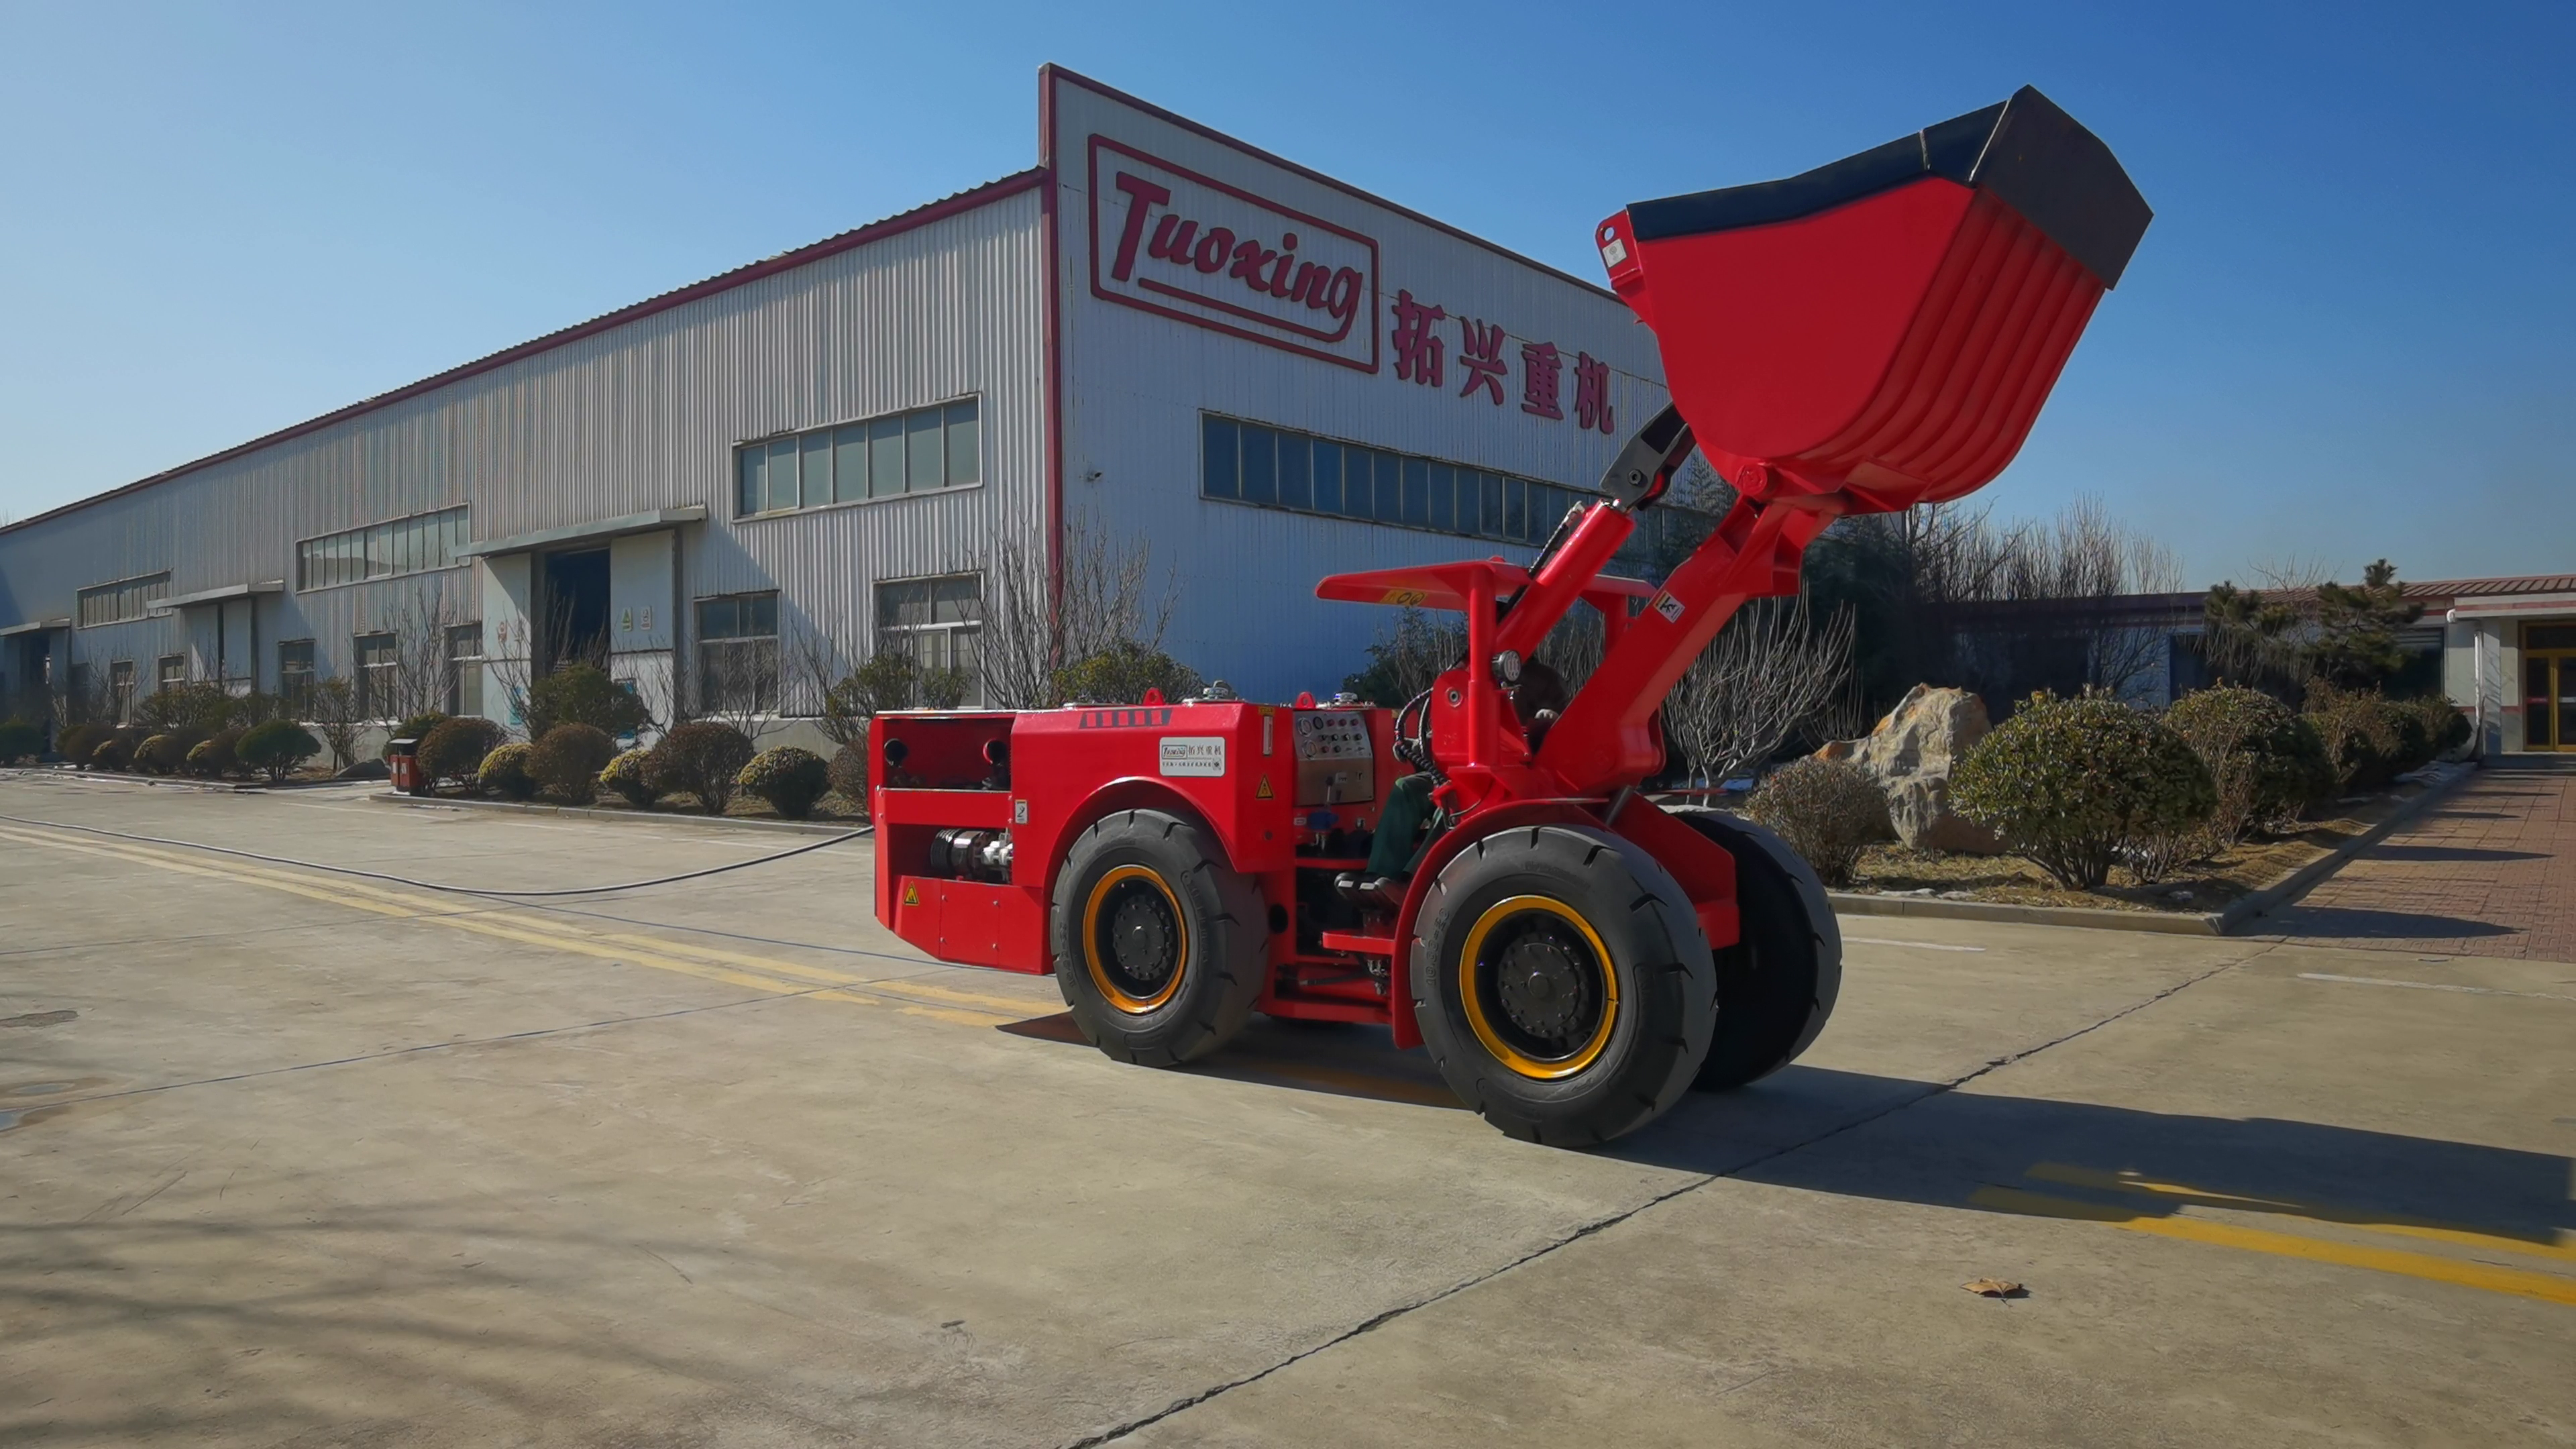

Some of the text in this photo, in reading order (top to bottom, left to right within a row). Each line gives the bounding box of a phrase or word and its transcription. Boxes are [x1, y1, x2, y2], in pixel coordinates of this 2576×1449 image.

[1112, 172, 1362, 342] Tuoxing
[1391, 289, 1615, 434] 拓兴重机
